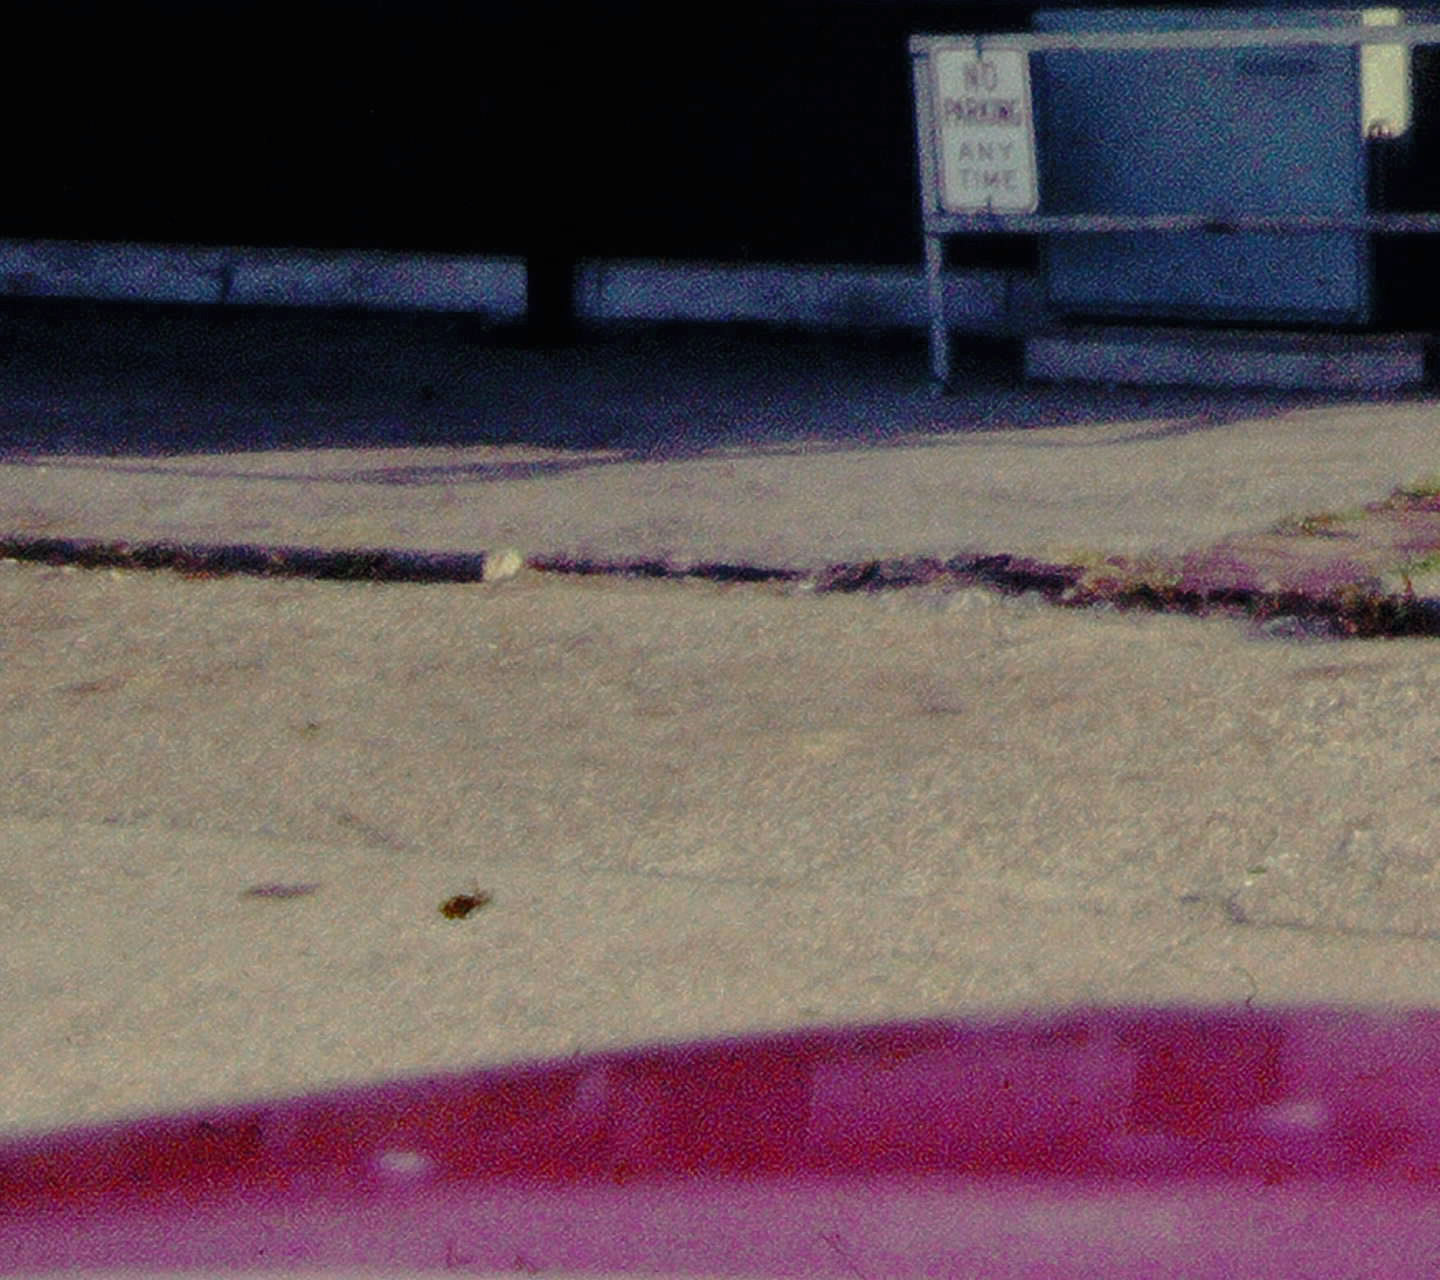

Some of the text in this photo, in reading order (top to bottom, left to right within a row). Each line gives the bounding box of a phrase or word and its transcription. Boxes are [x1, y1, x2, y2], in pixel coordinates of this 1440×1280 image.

[964, 60, 998, 91] NO
[944, 97, 1023, 127] PARKING
[960, 140, 1014, 161] ANY
[960, 168, 1020, 190] TIME
